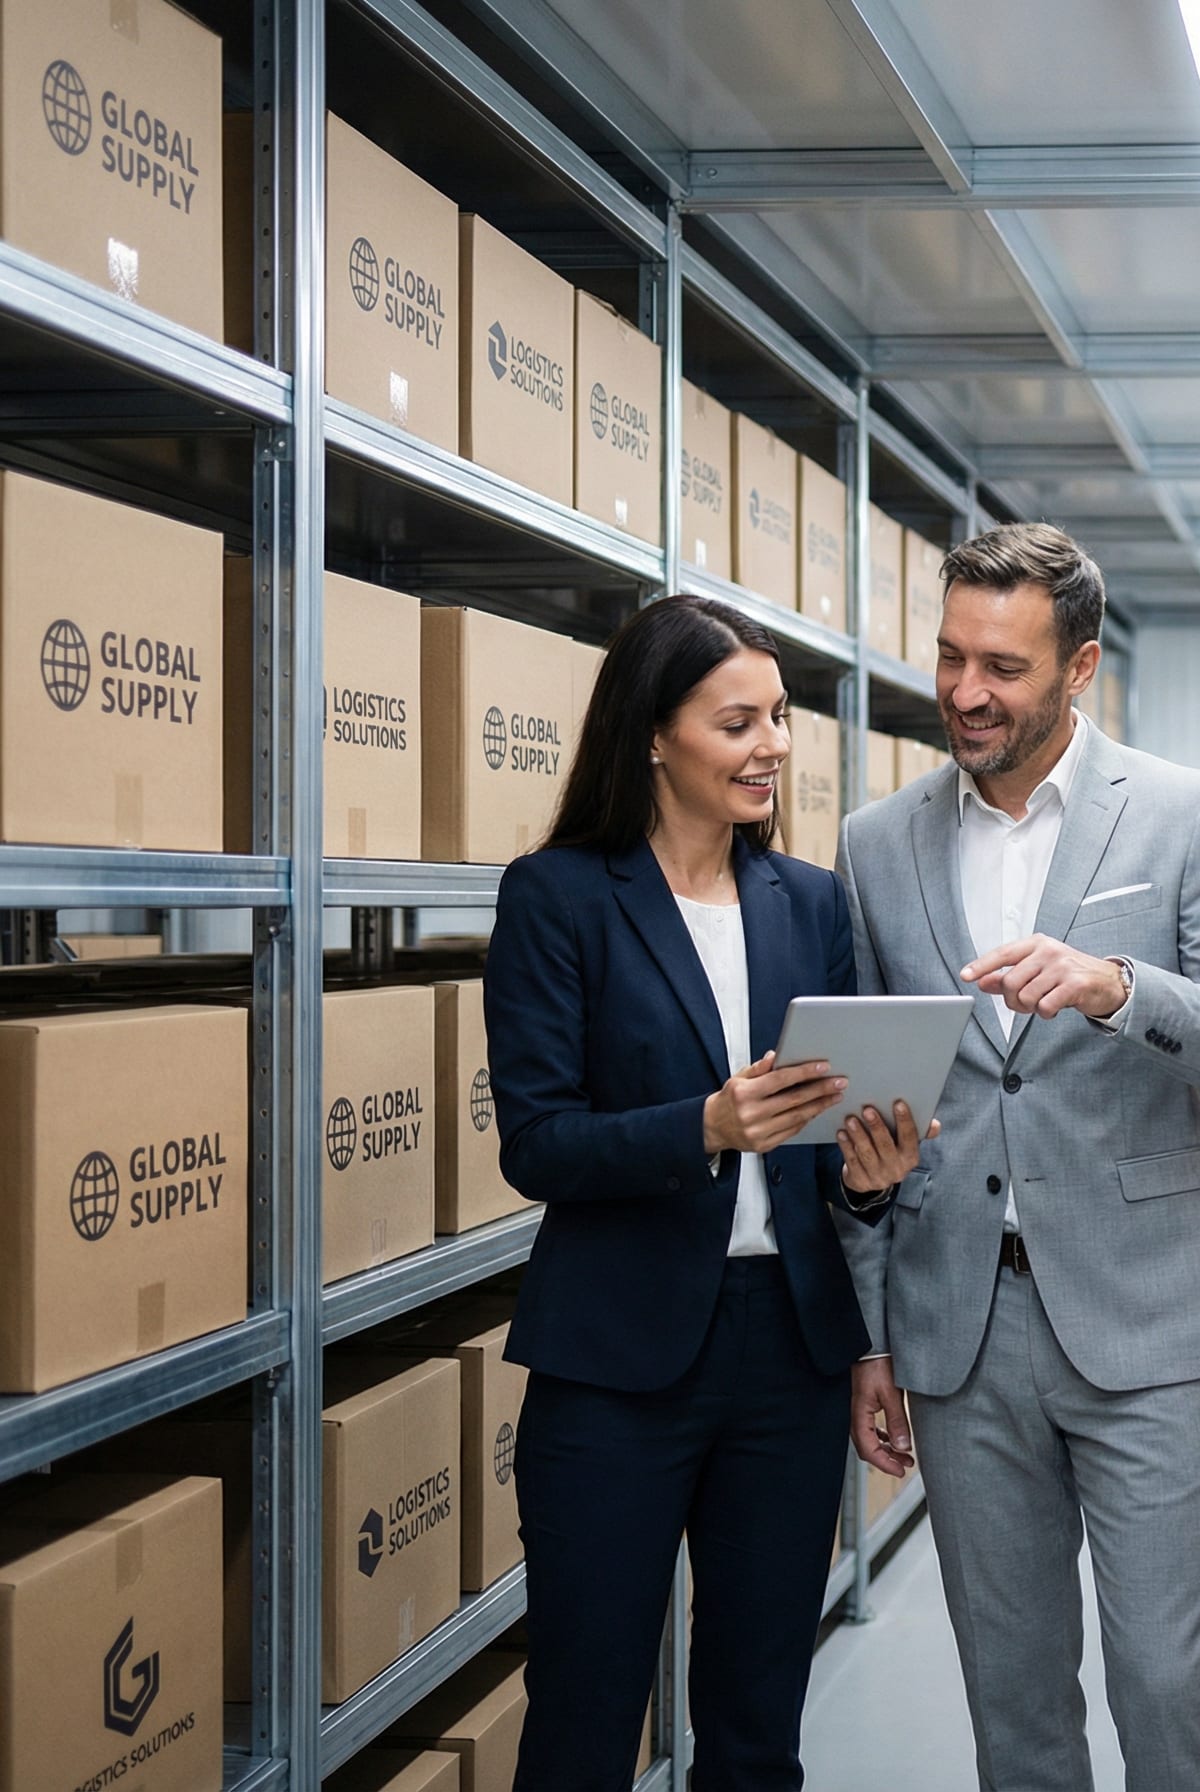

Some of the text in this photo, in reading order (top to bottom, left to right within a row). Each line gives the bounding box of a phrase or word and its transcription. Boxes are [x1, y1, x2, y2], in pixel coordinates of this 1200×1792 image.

[101, 90, 199, 177] GLOBAL
[101, 134, 195, 214] SUPPLY
[384, 257, 445, 319] GLOBAL
[384, 293, 443, 350] SUPPLY
[510, 336, 564, 388] LOGISTICS
[510, 364, 564, 412] SOLUTIONS
[611, 395, 650, 436] GLOBAL
[611, 422, 650, 463] SUPPLY
[101, 631, 201, 682] GLOBAL
[101, 676, 199, 725] SUPPLY
[333, 686, 406, 724] LOGISTICS
[333, 719, 407, 751] SOLUTIONS
[511, 713, 561, 746] GLOBAL
[511, 745, 560, 776] SUPPLY
[362, 1086, 423, 1125] GLOBAL
[129, 1132, 227, 1182] GLOBAL
[362, 1121, 421, 1162] SUPPLY
[130, 1173, 223, 1228] SUPPLY
[389, 1467, 450, 1526] LOGISTICS
[389, 1496, 451, 1556] SOLUTIONS
[130, 1711, 196, 1768] SOLUTIONS
